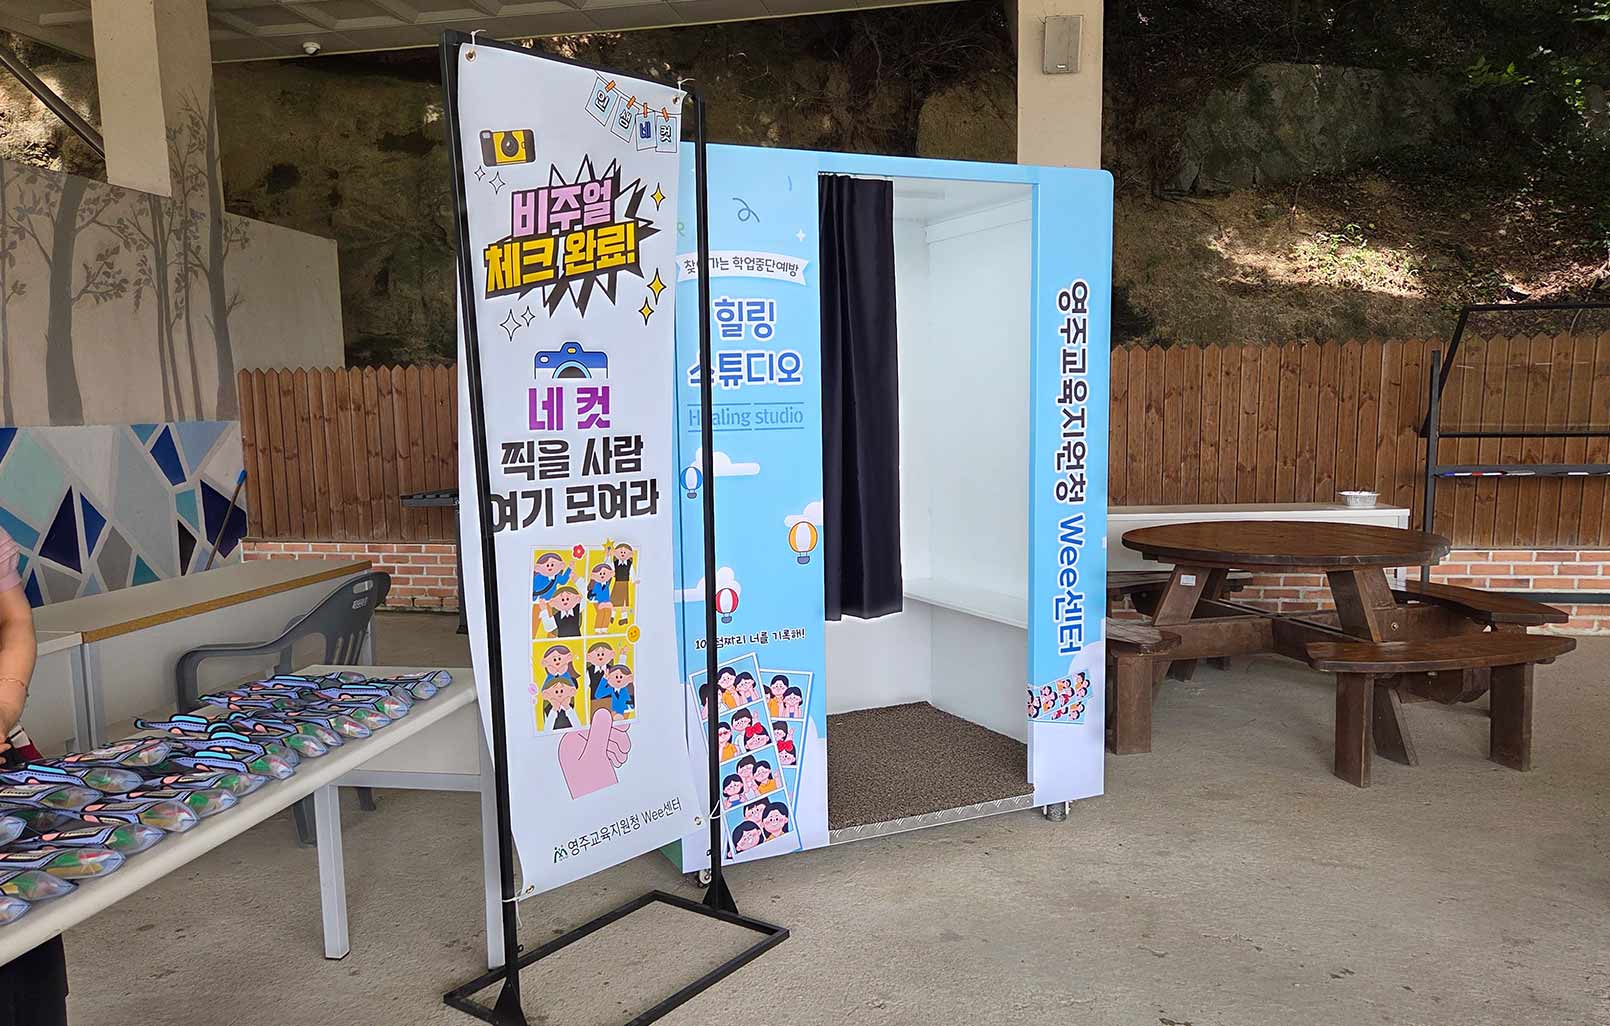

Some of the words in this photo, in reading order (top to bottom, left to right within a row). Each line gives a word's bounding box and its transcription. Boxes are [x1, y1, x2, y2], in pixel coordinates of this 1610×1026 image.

[512, 178, 614, 238] 비주얼
[484, 236, 556, 294] 체크
[563, 221, 636, 276] 완료!
[683, 256, 730, 274] 찾가는
[732, 255, 799, 277] 학업중단예방
[714, 298, 775, 339] 힐링
[528, 386, 564, 431] 네
[576, 385, 611, 430] 컷
[688, 407, 752, 427] Haling
[755, 406, 804, 424] studio
[1056, 281, 1088, 503] 영주교육지원청
[501, 439, 570, 481] 찍을
[581, 434, 644, 477] 사람
[490, 487, 554, 533] 여기
[566, 478, 660, 524] 모여라
[1055, 514, 1084, 654] Wee센터
[695, 634, 746, 649] 10점짜리
[750, 631, 769, 644] 너를
[772, 628, 805, 640] 기록해!
[567, 814, 641, 856] 영주교육지원청
[641, 797, 682, 824] Wee센터
